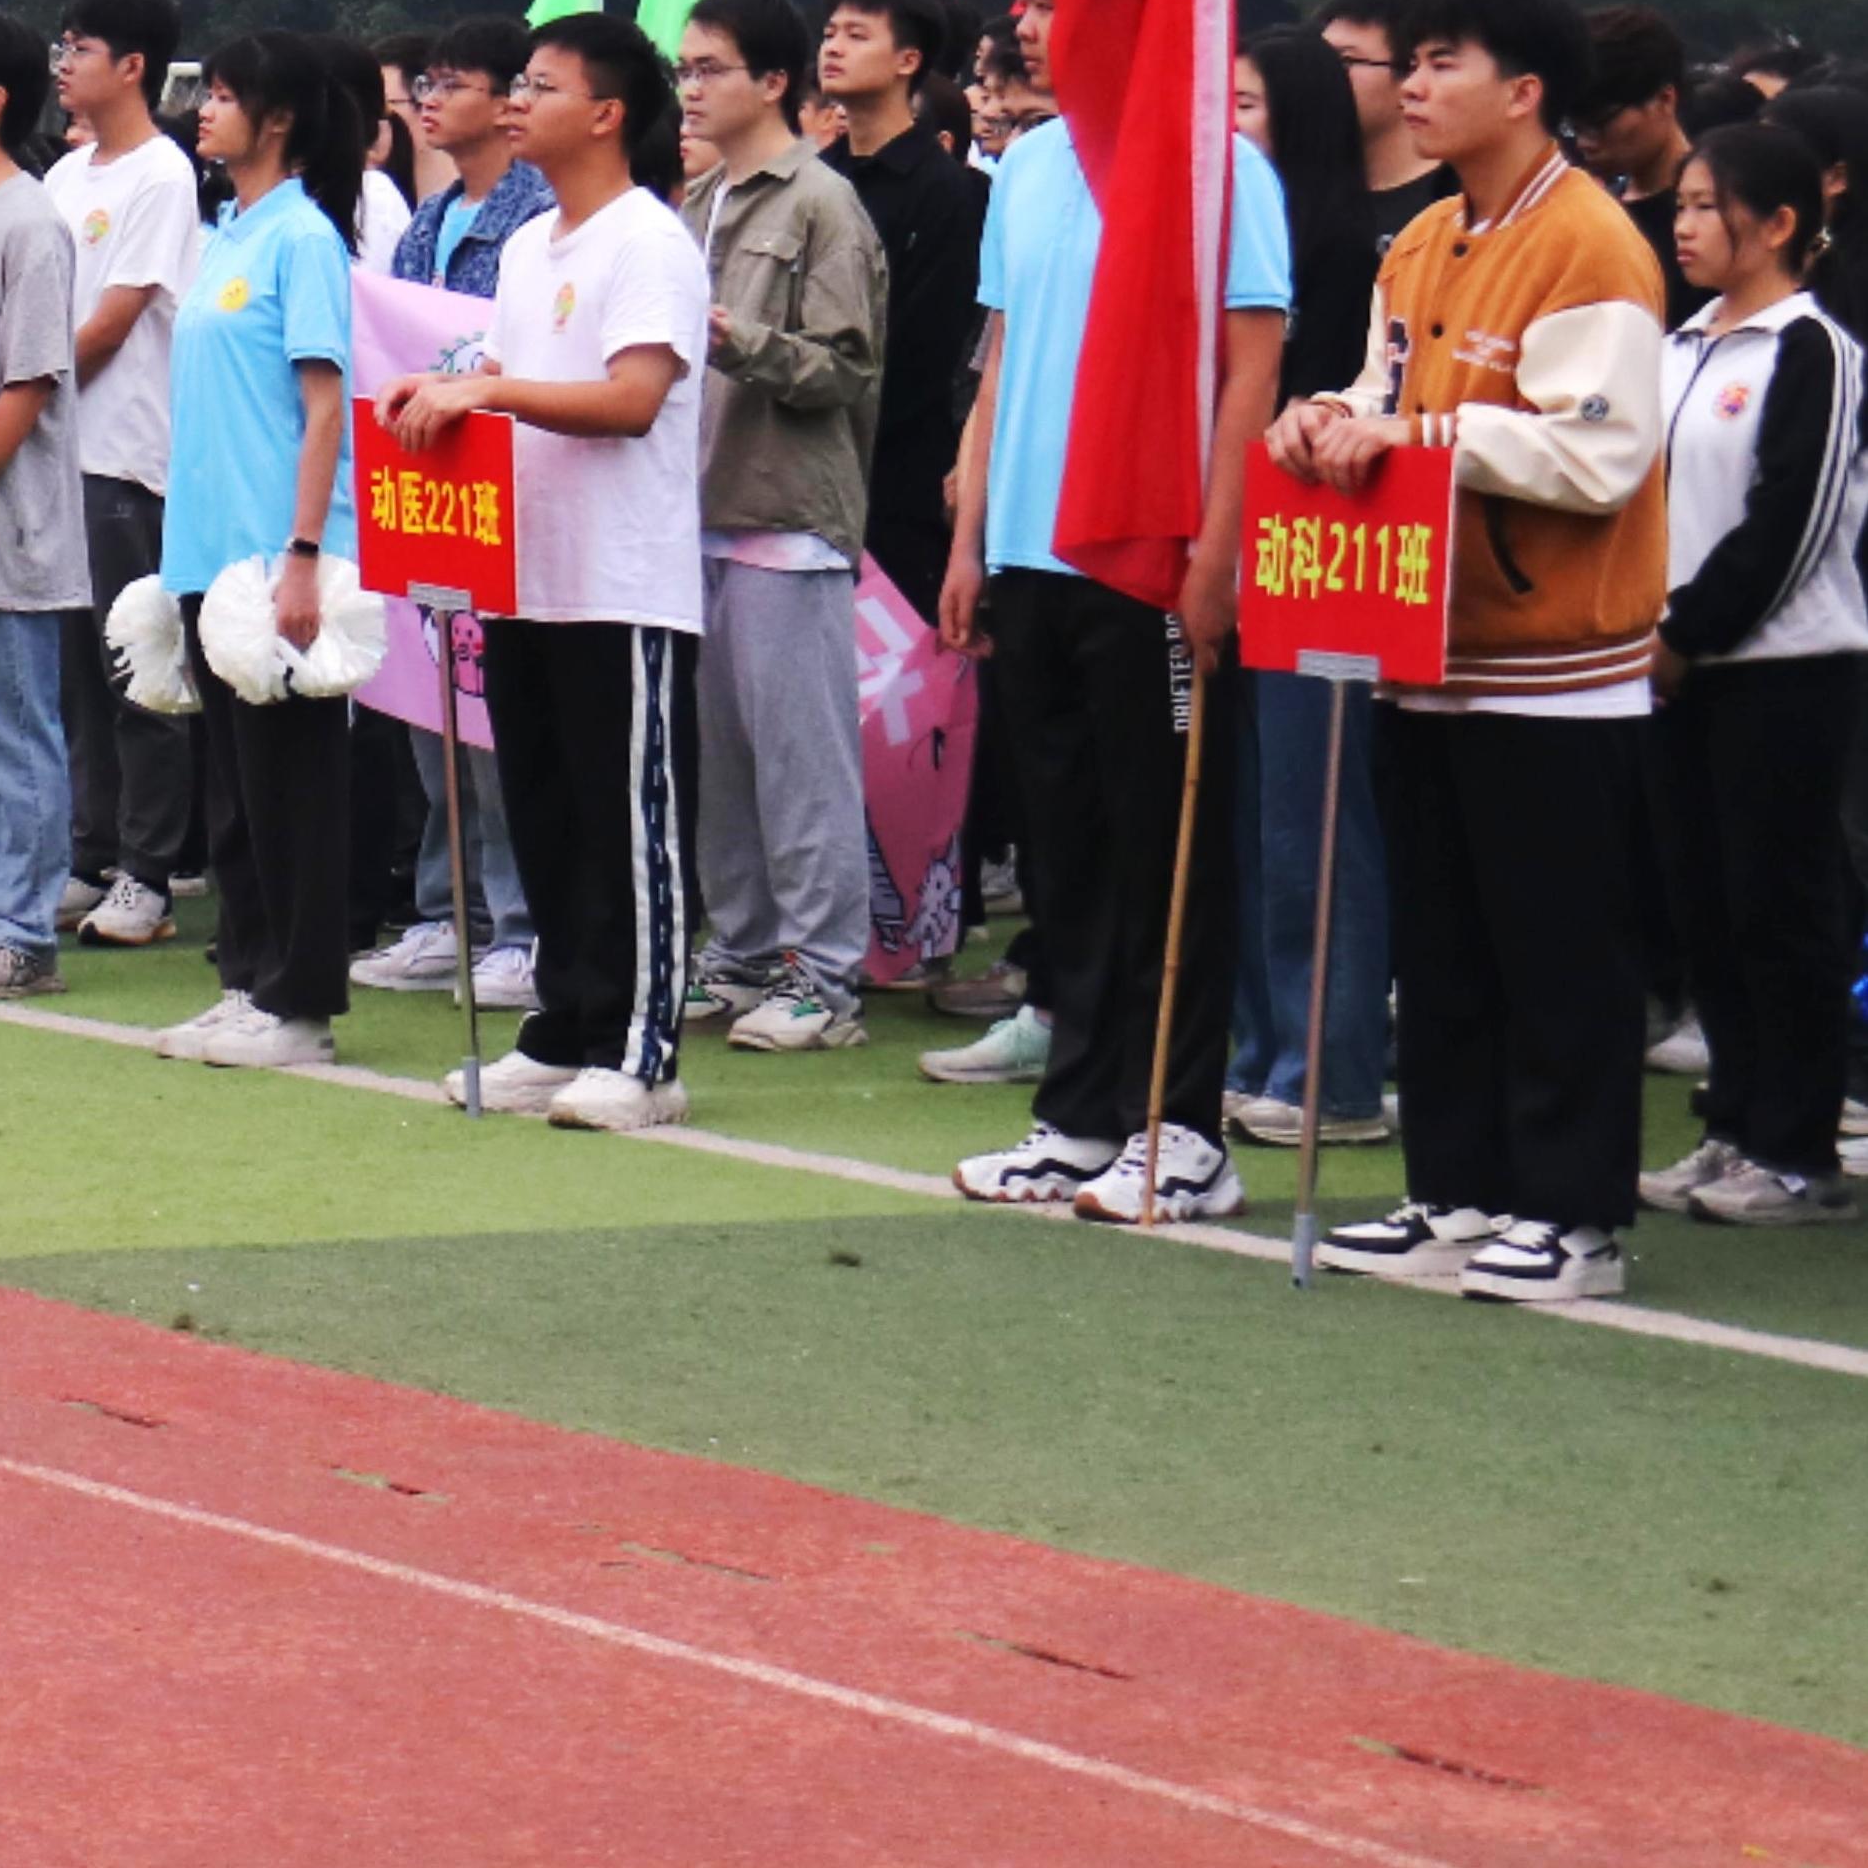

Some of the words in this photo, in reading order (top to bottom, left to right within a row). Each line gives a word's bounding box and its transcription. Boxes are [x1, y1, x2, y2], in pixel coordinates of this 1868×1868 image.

[370, 465, 502, 546] 动医221班
[1256, 512, 1432, 606] 动科211班
